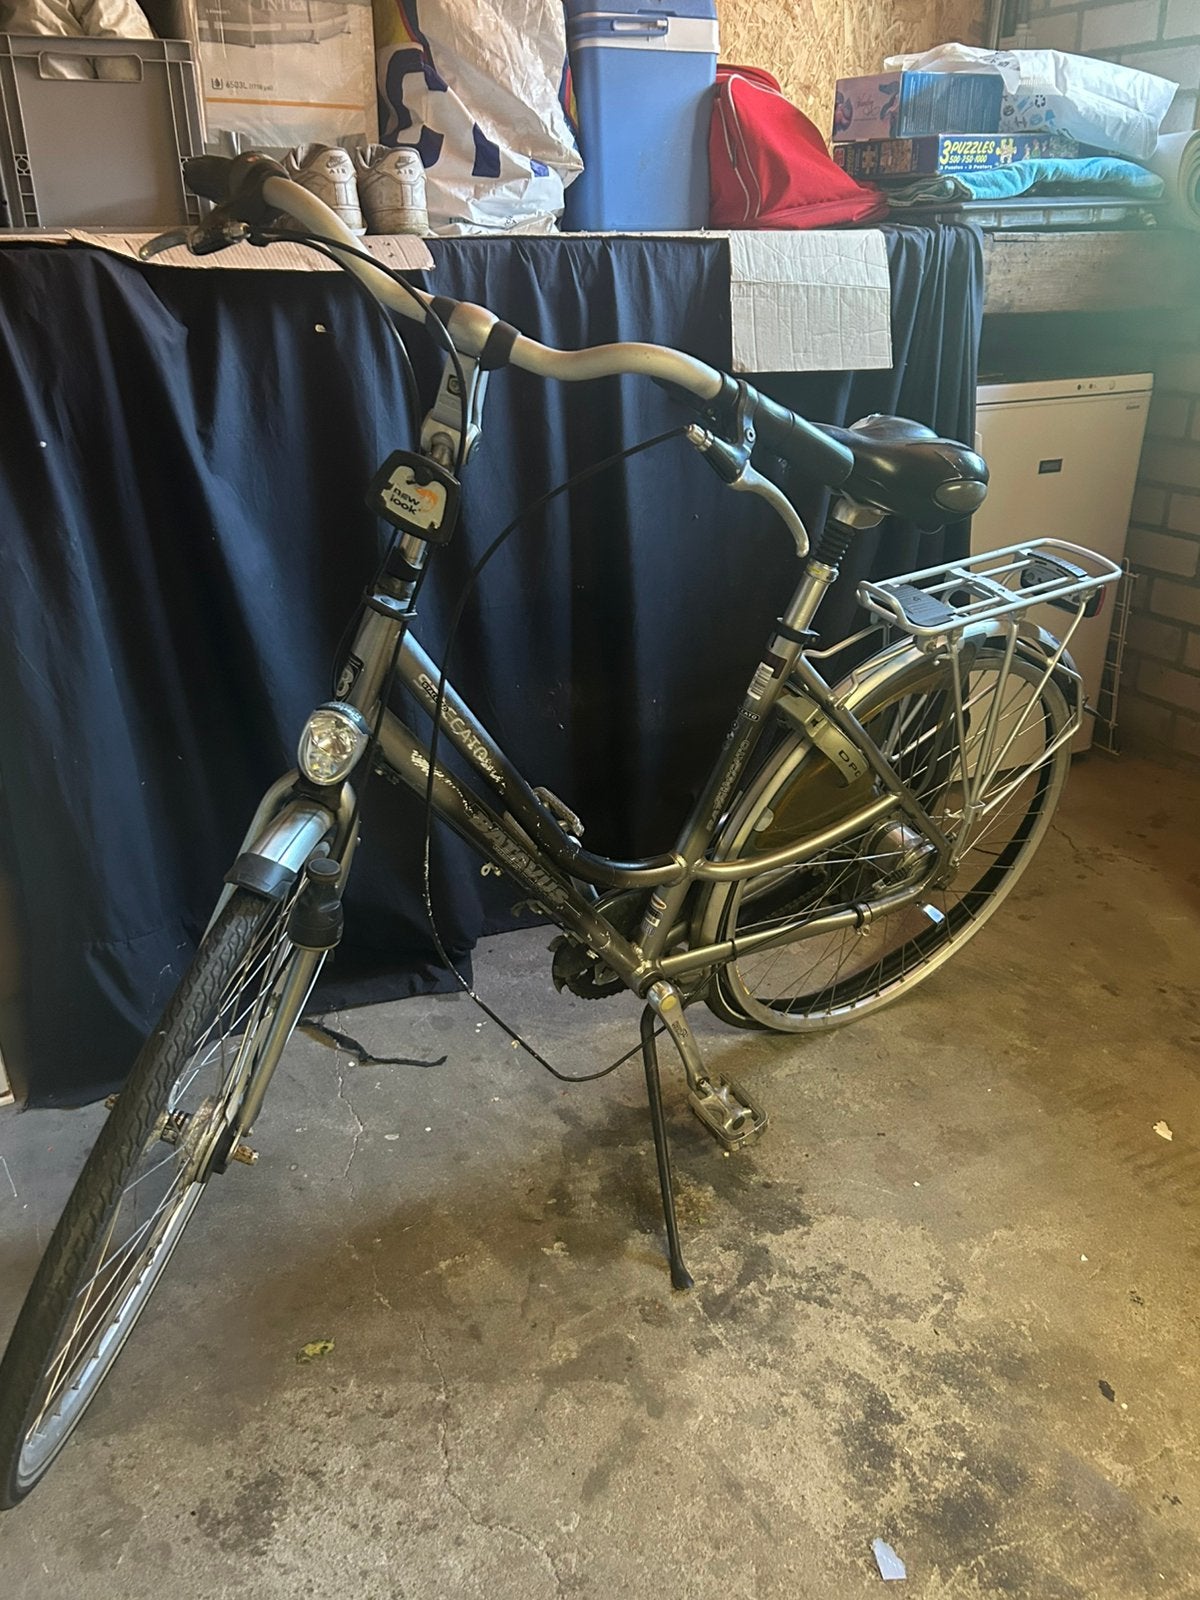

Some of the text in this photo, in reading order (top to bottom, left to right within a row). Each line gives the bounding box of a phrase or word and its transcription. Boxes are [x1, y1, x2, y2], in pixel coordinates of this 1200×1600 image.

[940, 140, 995, 164] 3 PUZZLES
[397, 167, 413, 175] AIR
[390, 494, 417, 515] look
[393, 488, 420, 505] new
[413, 673, 488, 763] SCCATO
